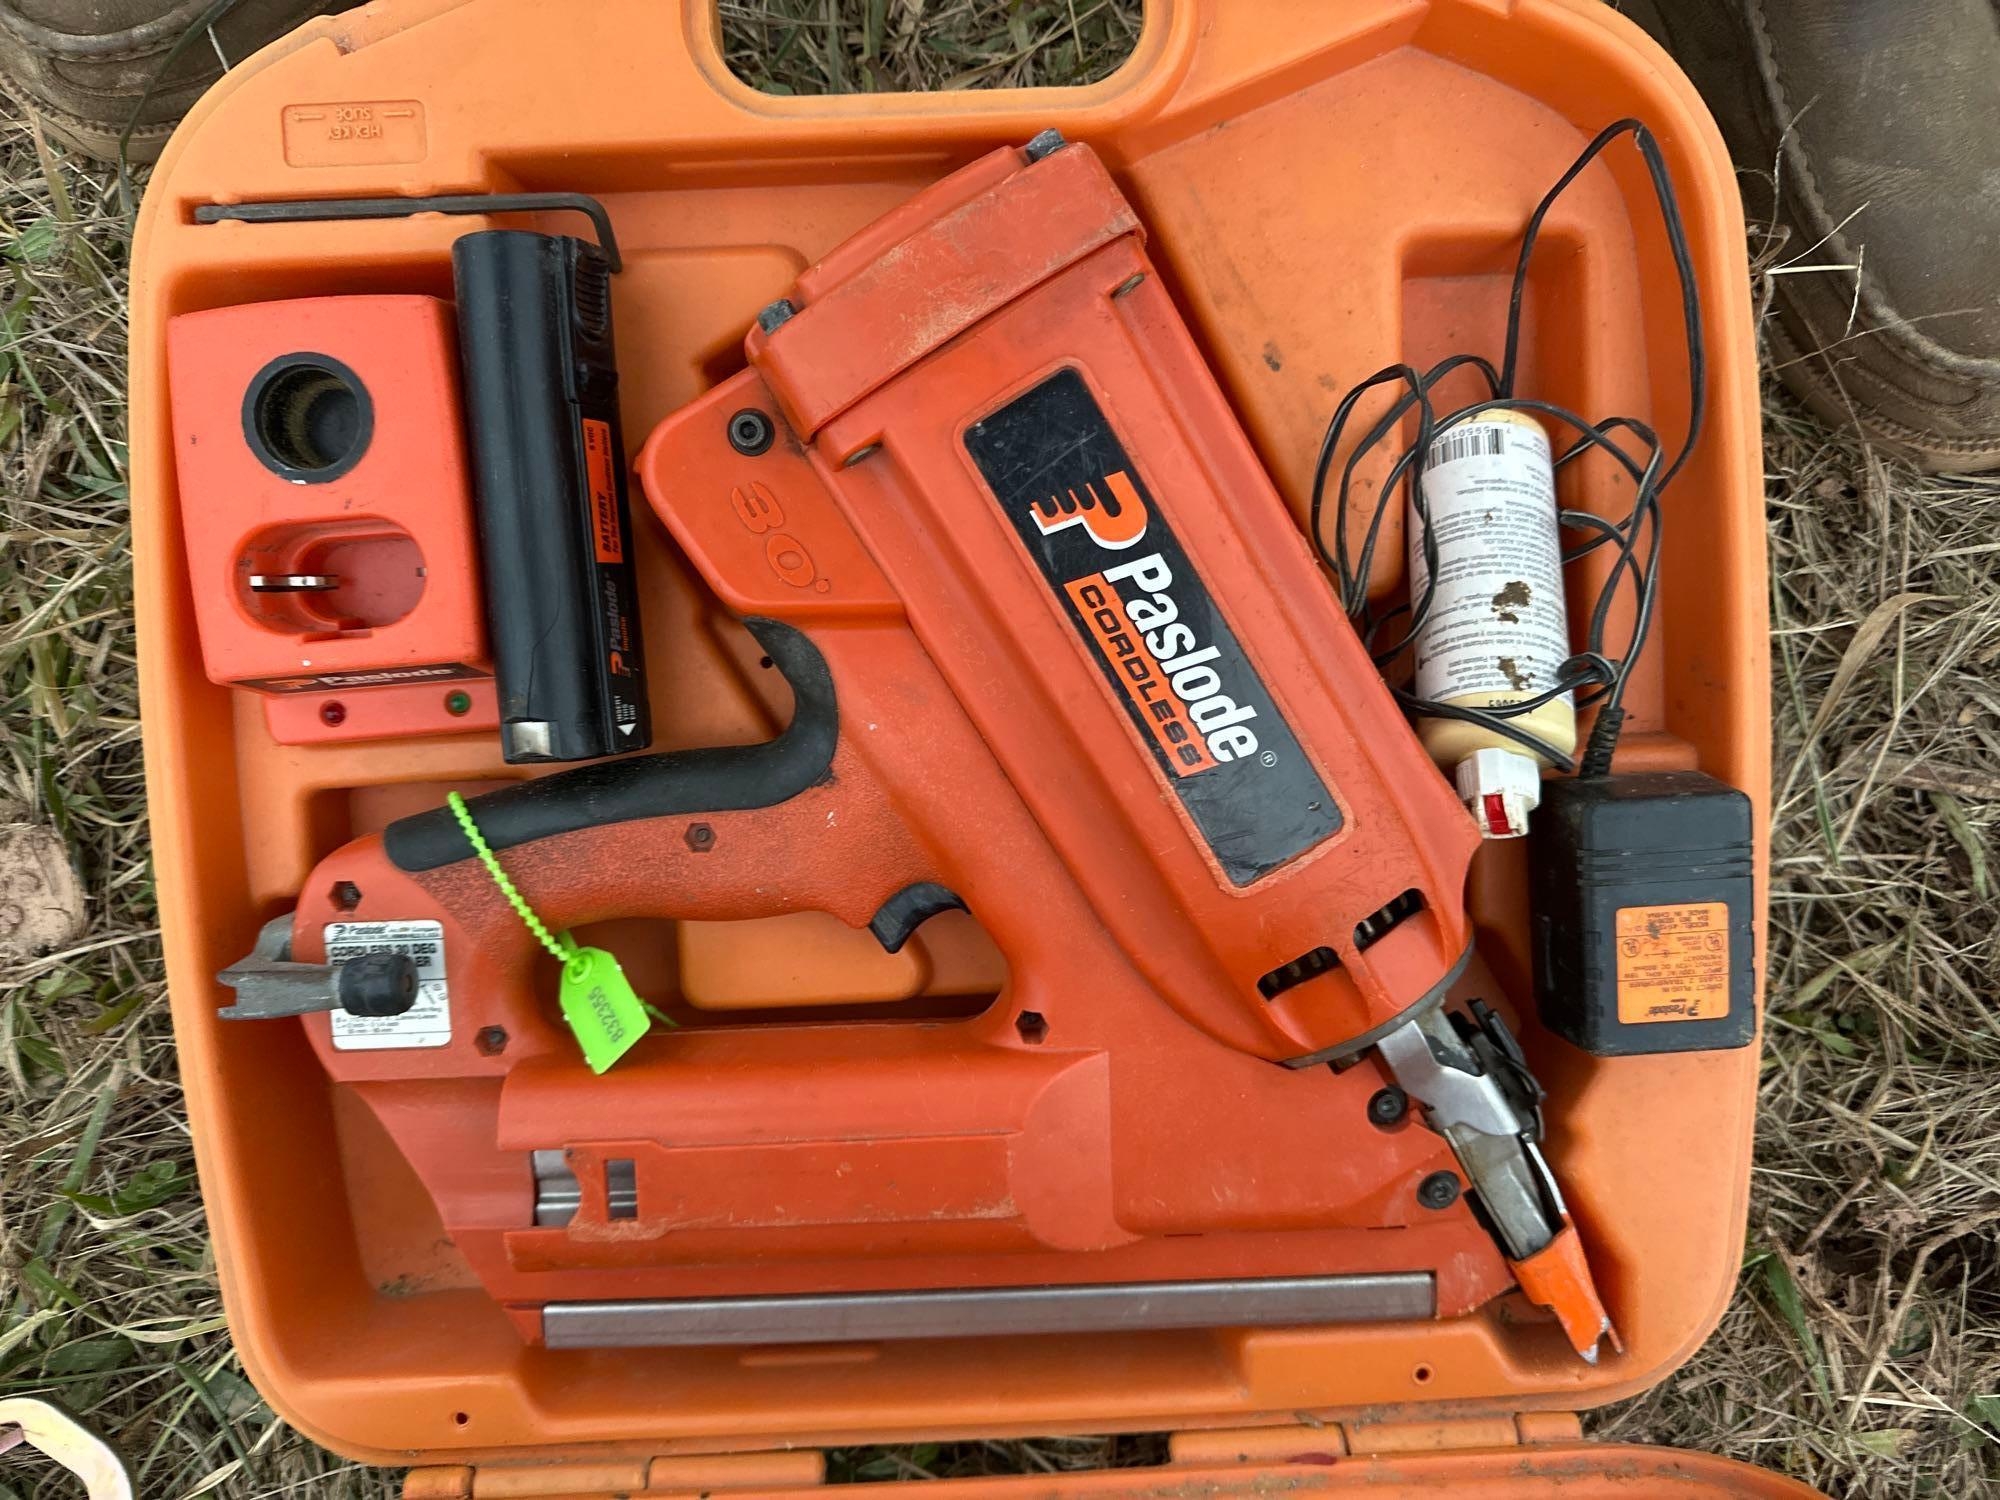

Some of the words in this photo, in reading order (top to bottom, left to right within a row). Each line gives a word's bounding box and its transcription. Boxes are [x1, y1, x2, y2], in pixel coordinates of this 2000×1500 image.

[327, 125, 352, 140] KEY
[354, 124, 382, 139] HEX
[597, 491, 611, 552] BATTERY
[1101, 552, 1260, 764] Paslode
[317, 668, 454, 684] Paslode
[1078, 583, 1204, 768] CORDLESS
[331, 944, 391, 956] CORDLESS
[413, 943, 436, 953] DEG
